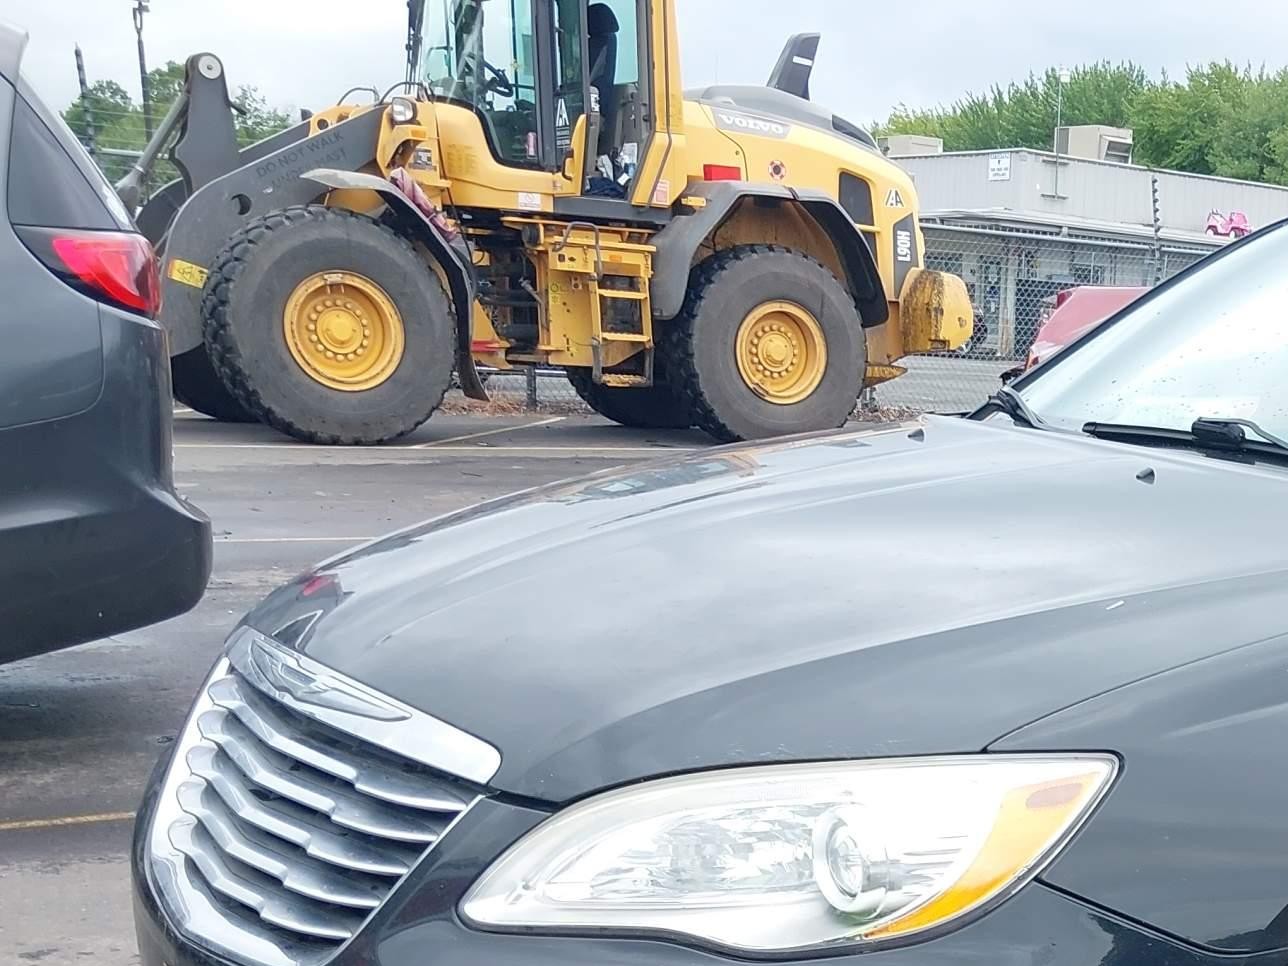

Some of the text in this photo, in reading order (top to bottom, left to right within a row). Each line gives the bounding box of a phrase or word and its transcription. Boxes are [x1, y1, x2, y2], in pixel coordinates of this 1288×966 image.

[718, 113, 784, 135] VOLVO
[255, 131, 344, 178] DO NOT WALK
[896, 230, 911, 262] L90H
